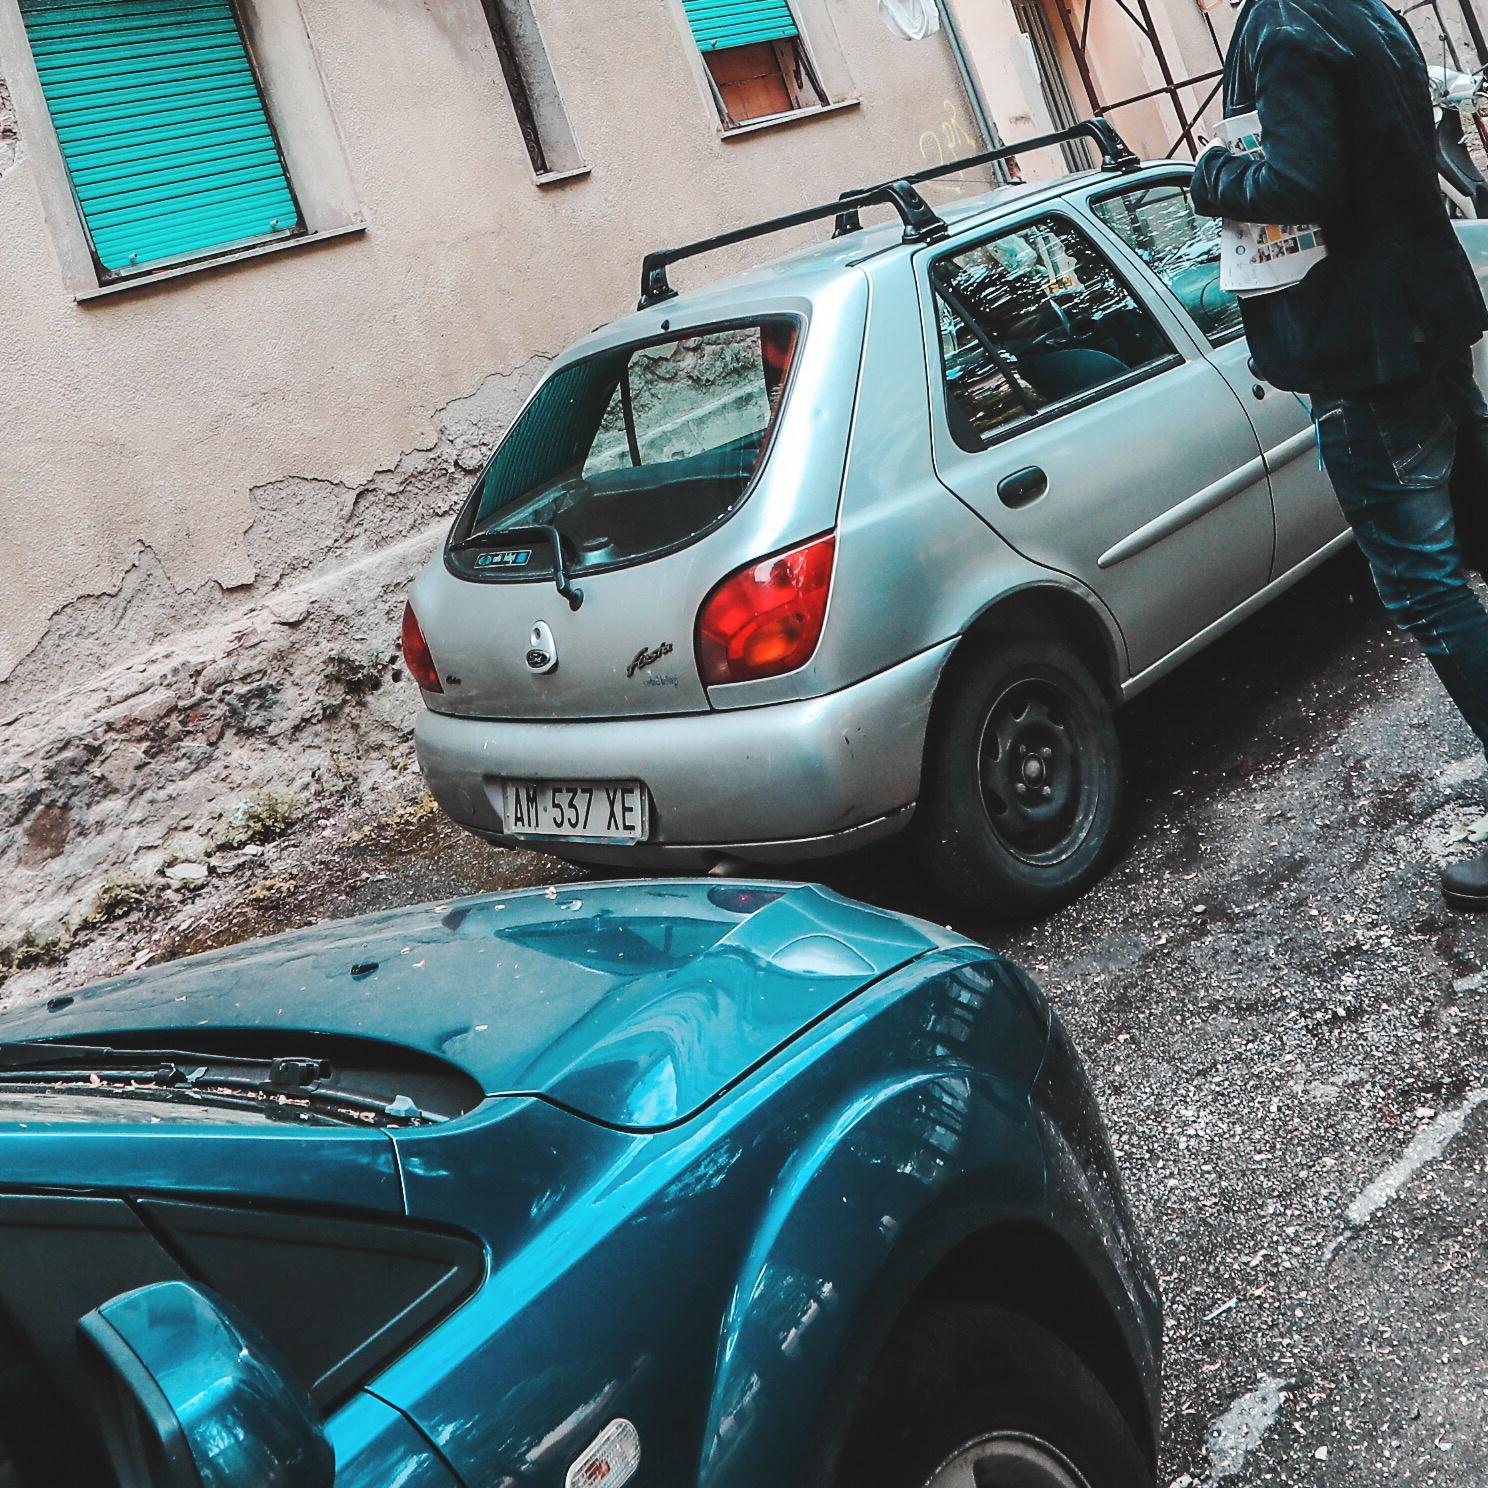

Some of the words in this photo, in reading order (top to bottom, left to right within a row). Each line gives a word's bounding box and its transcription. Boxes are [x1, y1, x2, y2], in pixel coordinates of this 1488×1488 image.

[514, 787, 539, 827] AM
[552, 787, 593, 829] 537
[604, 787, 636, 831] XE
